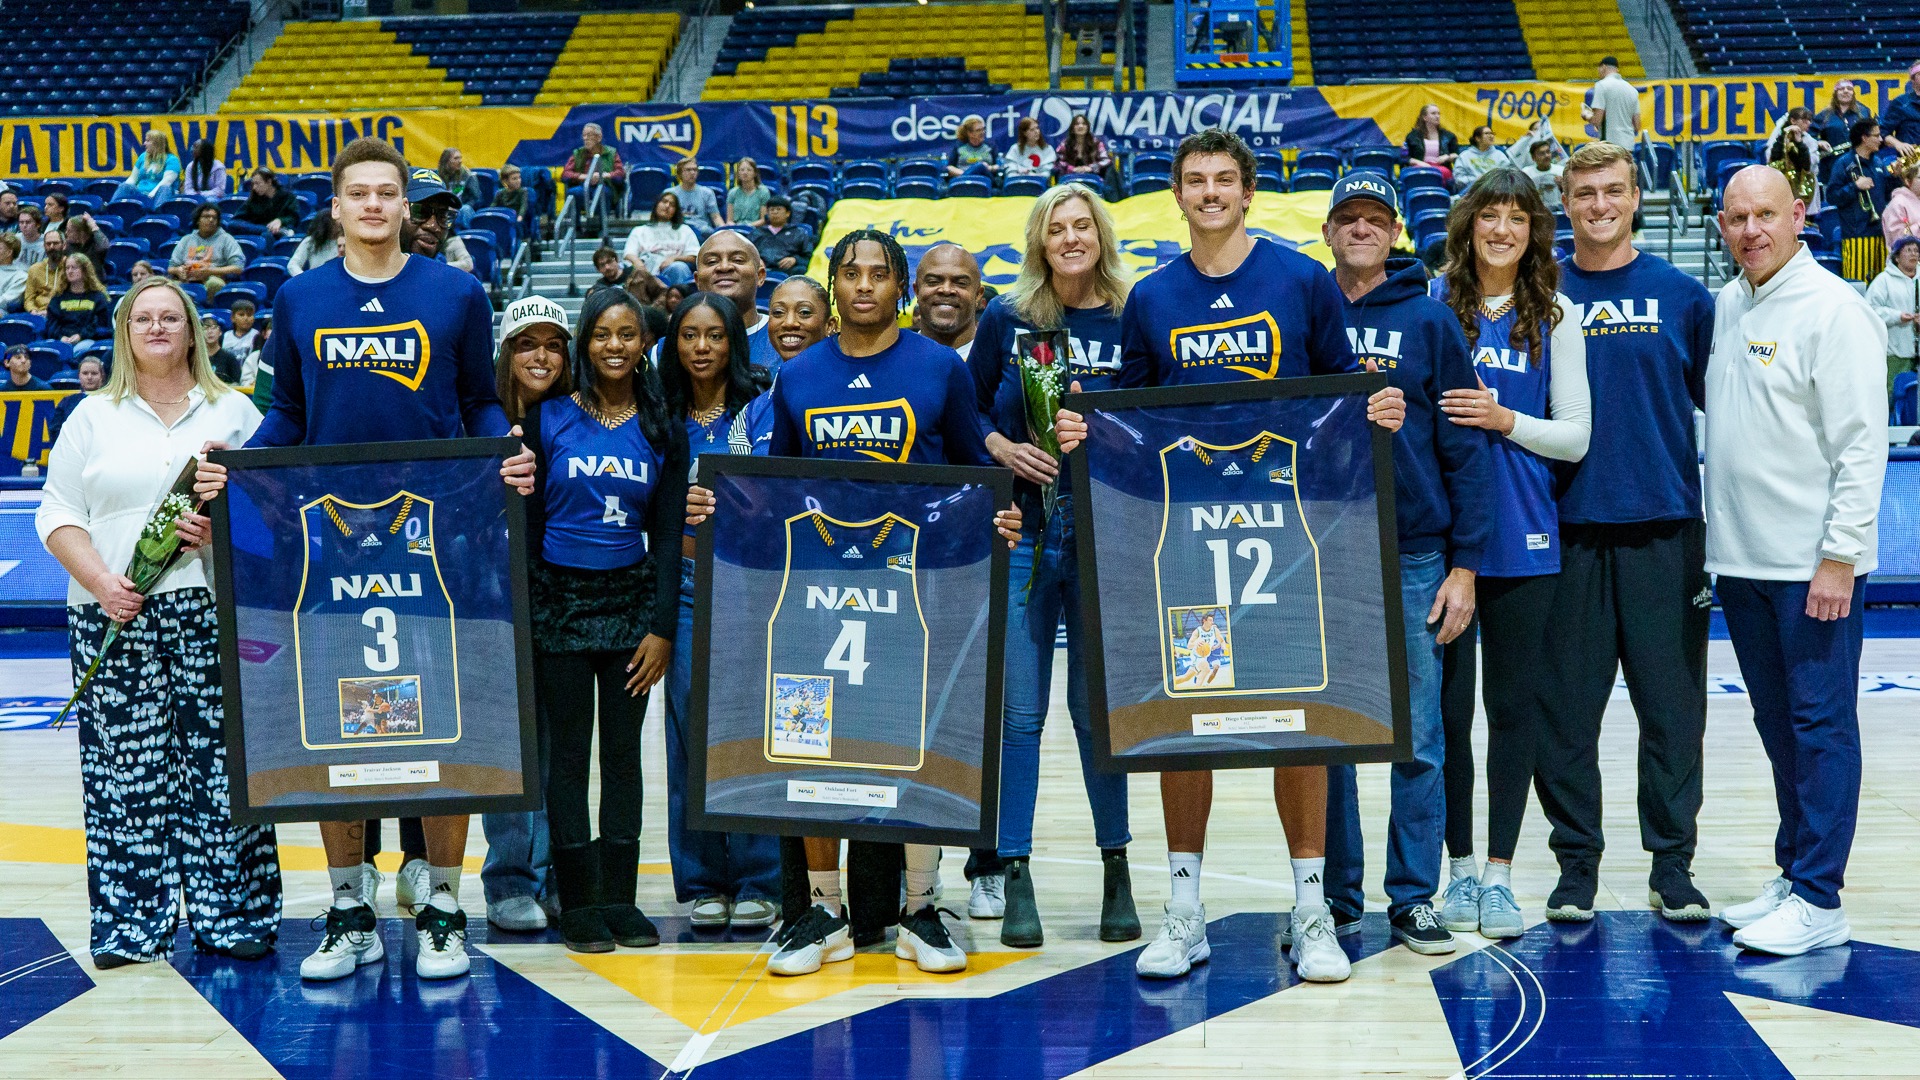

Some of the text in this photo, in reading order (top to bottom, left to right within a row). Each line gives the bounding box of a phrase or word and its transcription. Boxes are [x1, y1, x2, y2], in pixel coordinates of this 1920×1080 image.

[624, 123, 692, 143] NAU
[770, 104, 839, 158] 113
[0, 121, 152, 174] ATION
[1345, 180, 1386, 196] NAU
[512, 303, 563, 323] OAKLAND
[325, 337, 415, 361] NAU
[1181, 329, 1269, 361] NAU
[1749, 345, 1773, 356] NAU
[327, 361, 414, 370] BASKETBALL
[1183, 353, 1269, 369] BASKETBALL
[814, 415, 902, 442] NAU
[816, 440, 899, 450] BASKETBALL
[568, 455, 648, 484] NAU
[602, 495, 629, 528] 4
[1191, 503, 1285, 532] NAU
[1204, 537, 1277, 606] 12
[330, 573, 422, 601] NAU
[806, 585, 898, 614] NAU
[361, 606, 399, 672] 3
[823, 619, 871, 686] 4
